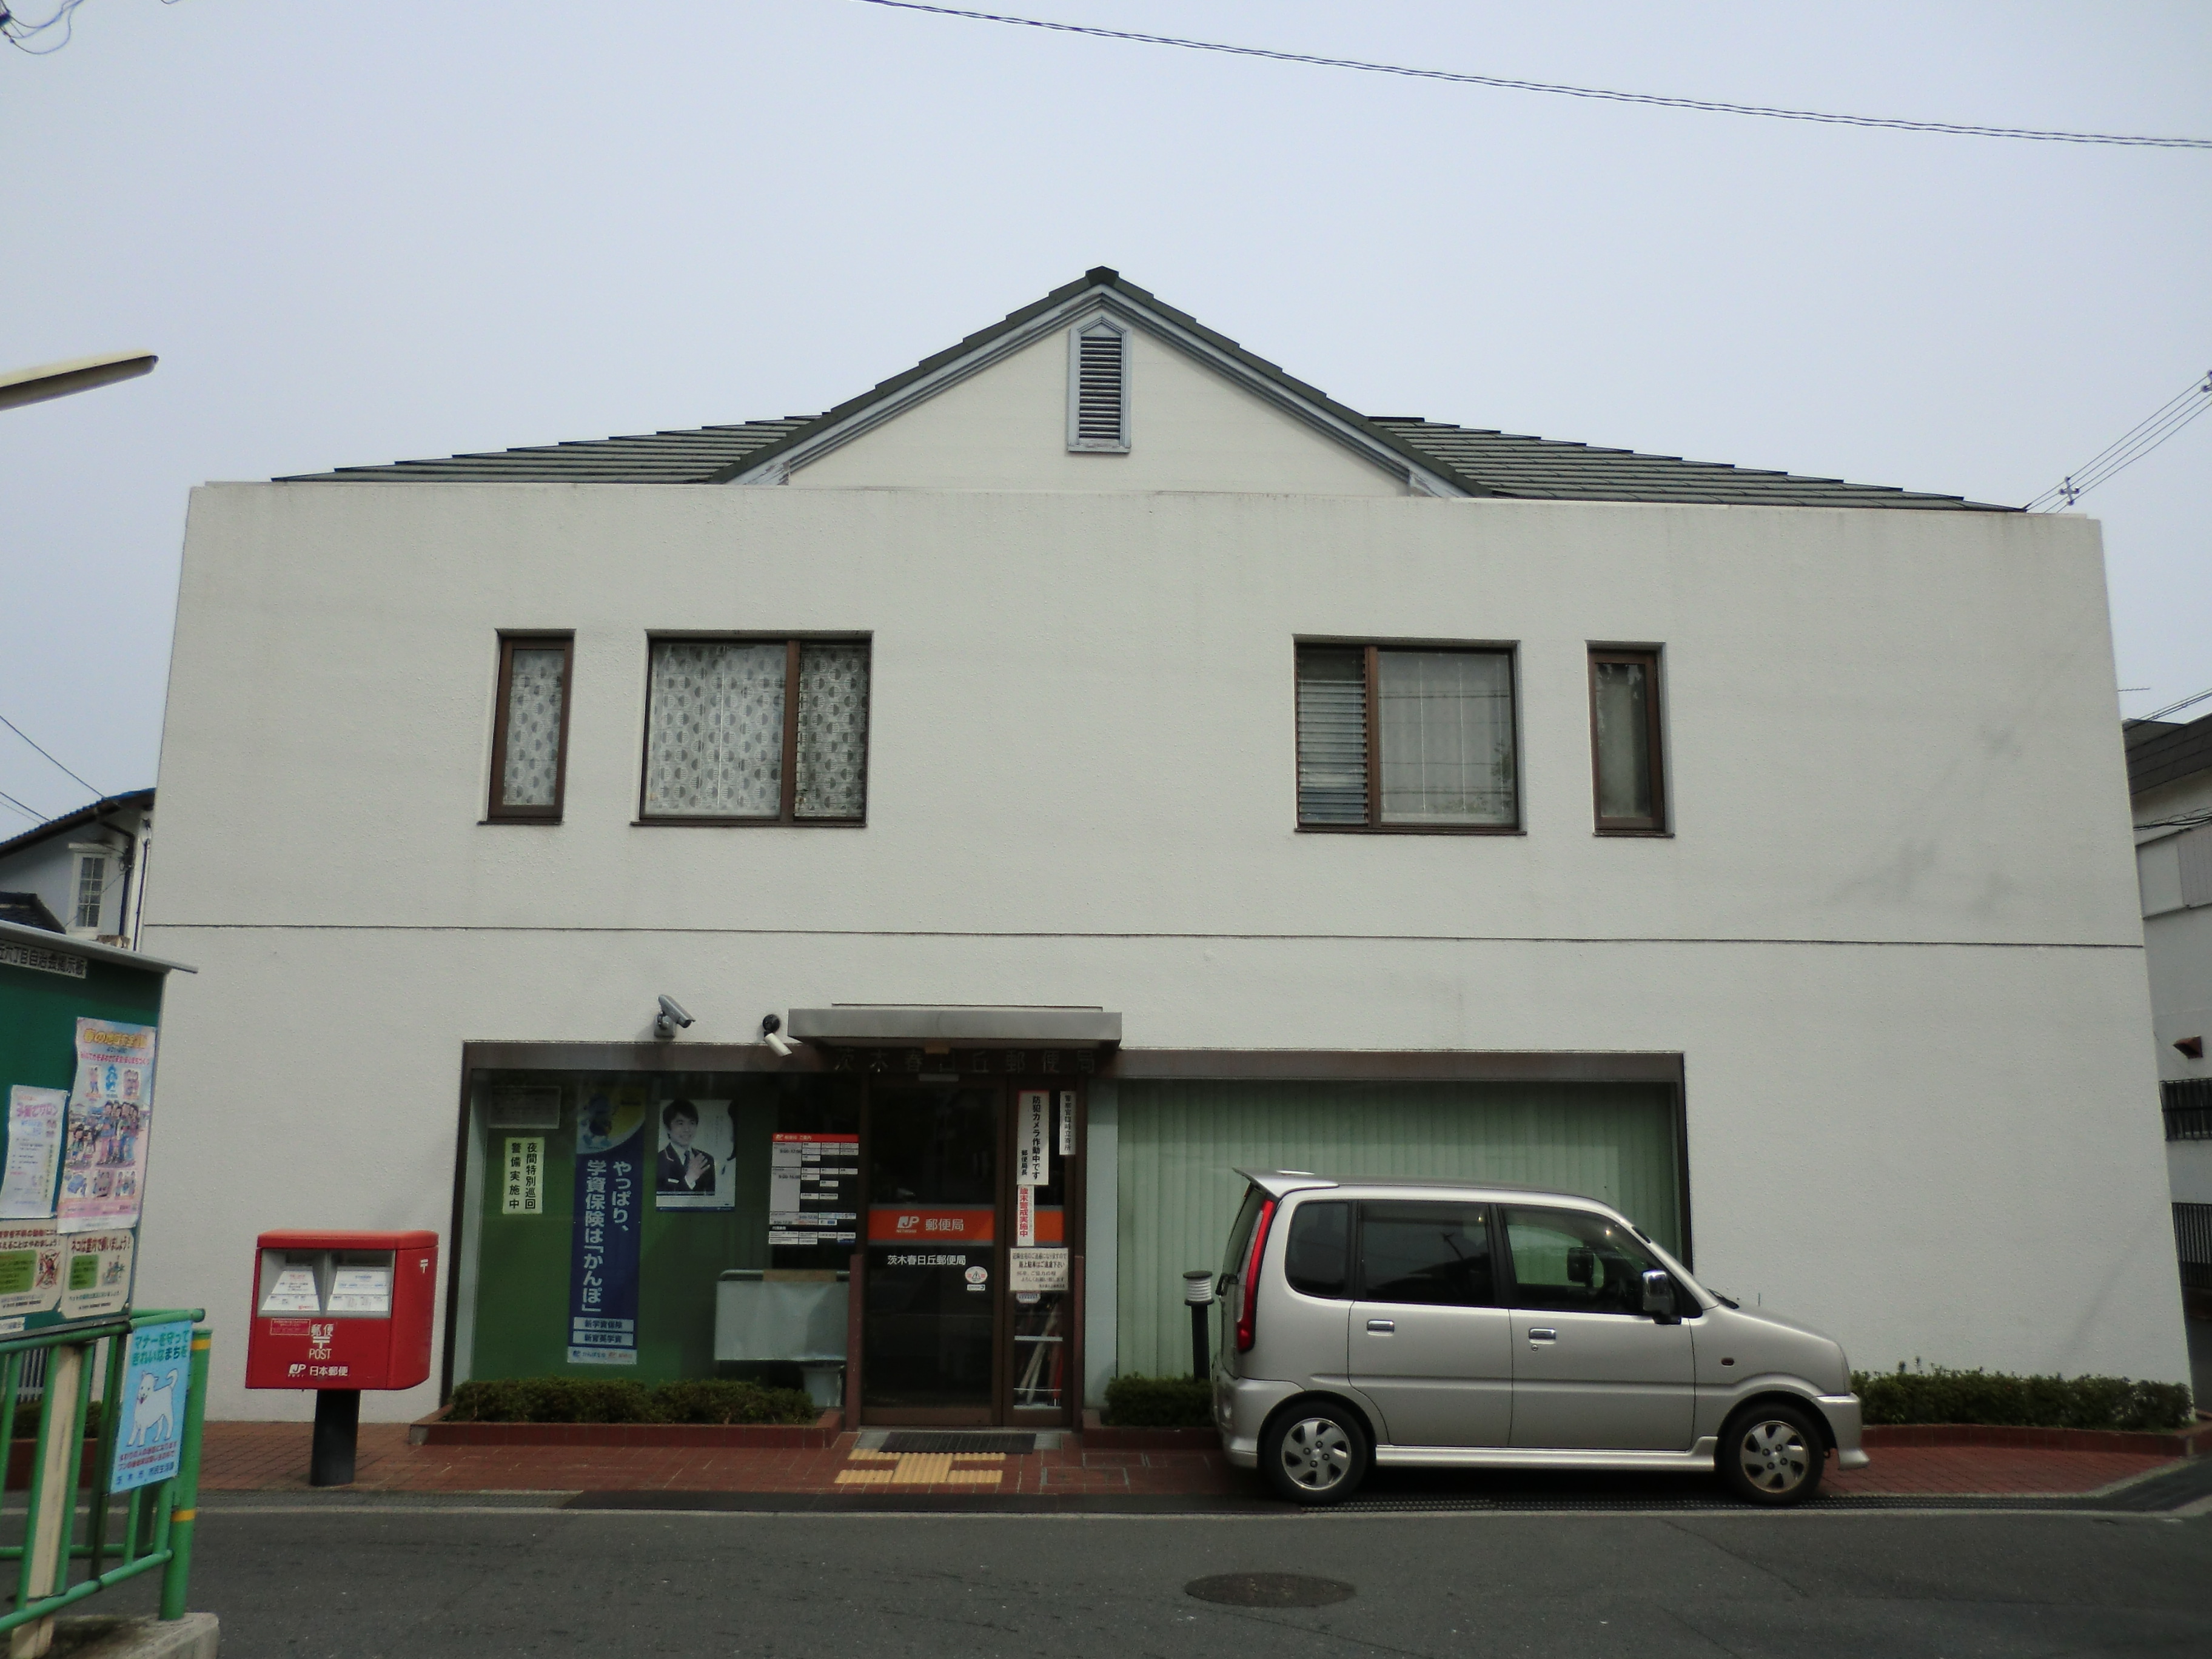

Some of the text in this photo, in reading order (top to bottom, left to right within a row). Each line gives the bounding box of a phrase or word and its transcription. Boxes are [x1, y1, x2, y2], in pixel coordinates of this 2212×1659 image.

[1032, 1095, 1041, 1180] 防犯カメラ作動中です
[509, 1143, 521, 1208] 警備実施中
[525, 1143, 537, 1209] 夜間特別巡回
[611, 1161, 632, 1232] やっぱり、
[925, 1219, 964, 1232] 郵便局
[581, 1159, 607, 1312] 学資保険は「かんぽ」
[887, 1255, 966, 1265] 茨木春日丘郵便局
[135, 1330, 189, 1349] マナーを守って
[311, 1324, 333, 1337] 郵便
[133, 1346, 188, 1366] きれいなまちを
[309, 1349, 332, 1359] POST
[309, 1366, 348, 1376] 日本郵便
